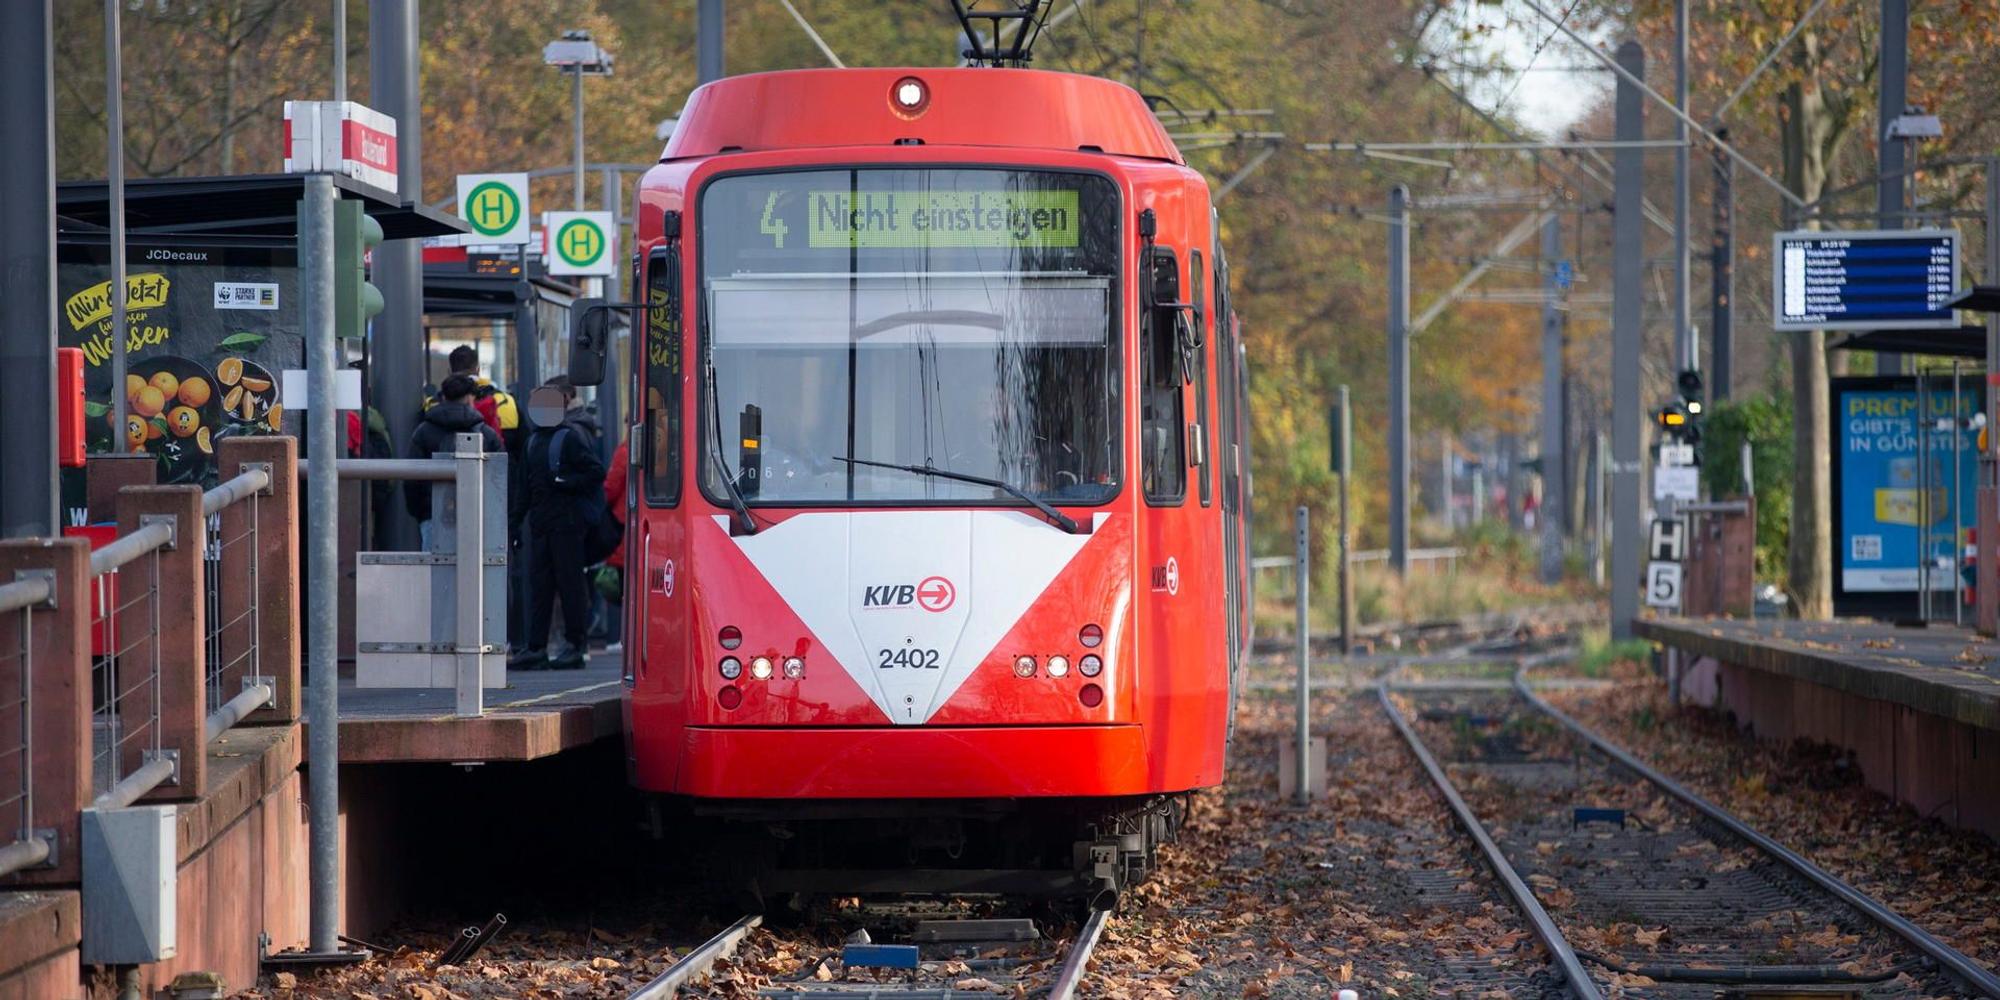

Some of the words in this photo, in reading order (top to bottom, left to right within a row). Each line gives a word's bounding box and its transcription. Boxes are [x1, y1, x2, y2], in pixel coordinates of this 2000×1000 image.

[481, 193, 505, 224] H
[761, 190, 788, 249] 4
[817, 193, 899, 232] Nicht
[911, 193, 1068, 241] einsteigen
[570, 229, 591, 256] H
[146, 250, 208, 261] JCDecaux
[68, 295, 104, 323] Wir
[1849, 397, 1971, 417] PREMUM
[1850, 435, 1870, 452] IN
[1652, 522, 1682, 559] H
[863, 585, 916, 607] KVB
[1654, 568, 1674, 600] 5
[879, 648, 940, 669] 2402
[907, 707, 912, 718] 1
